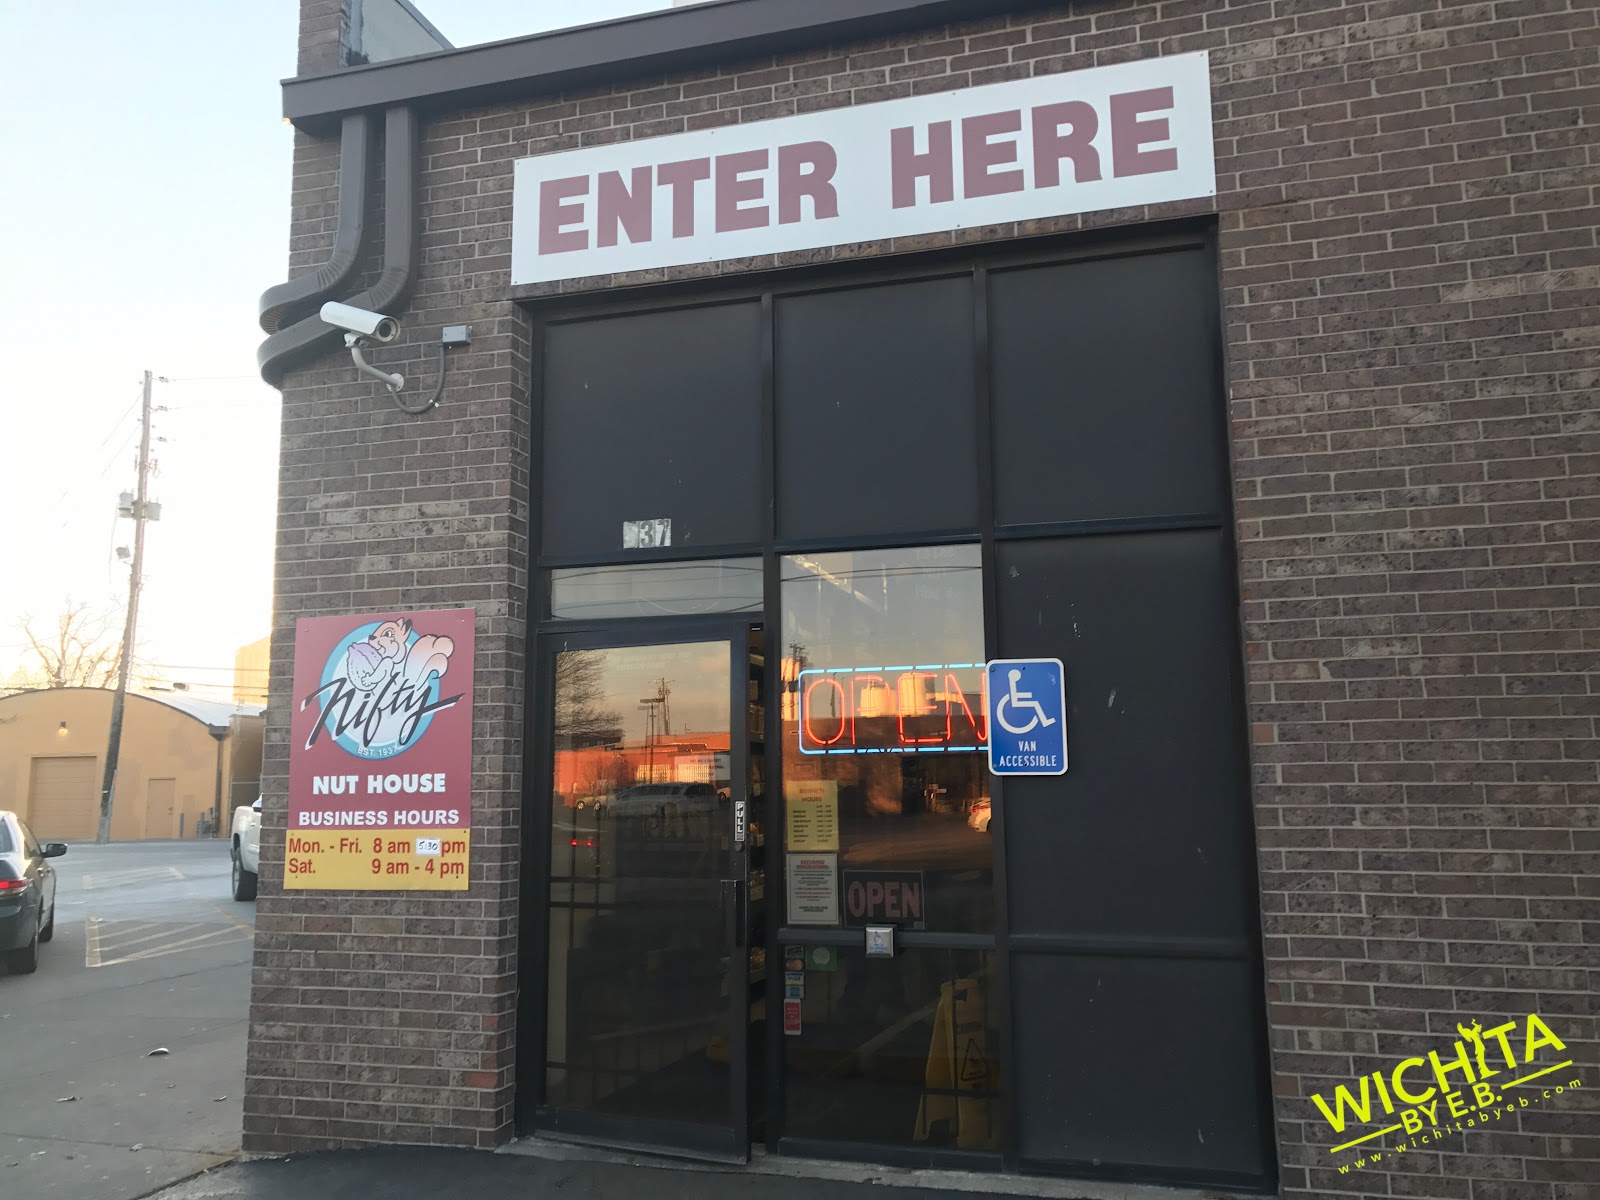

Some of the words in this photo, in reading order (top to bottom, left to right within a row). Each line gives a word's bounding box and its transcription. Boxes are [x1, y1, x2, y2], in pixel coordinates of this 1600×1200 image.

[538, 140, 839, 256] ENTER
[890, 86, 1178, 210] HERE
[301, 671, 466, 750] Nifty
[805, 671, 989, 746] OPEN
[378, 744, 398, 757] 1937
[1018, 740, 1037, 752] VAN
[998, 754, 1057, 768] ACCESSIBLE
[313, 775, 359, 795] NUT
[367, 773, 446, 794] HOUSE
[298, 810, 388, 826] BUSINESS
[393, 809, 459, 825] HOURS
[736, 802, 744, 833] PULL
[288, 837, 325, 854] Mon.
[340, 837, 362, 854] Fri.
[373, 837, 382, 854] 8
[387, 840, 411, 854] am
[418, 840, 439, 851] 5:30
[441, 840, 466, 858] pm
[288, 857, 316, 874] Sat.
[372, 858, 381, 875] 9
[386, 861, 409, 875] am
[425, 858, 434, 874] 4
[440, 861, 464, 879] pm
[847, 879, 921, 919] OPEN
